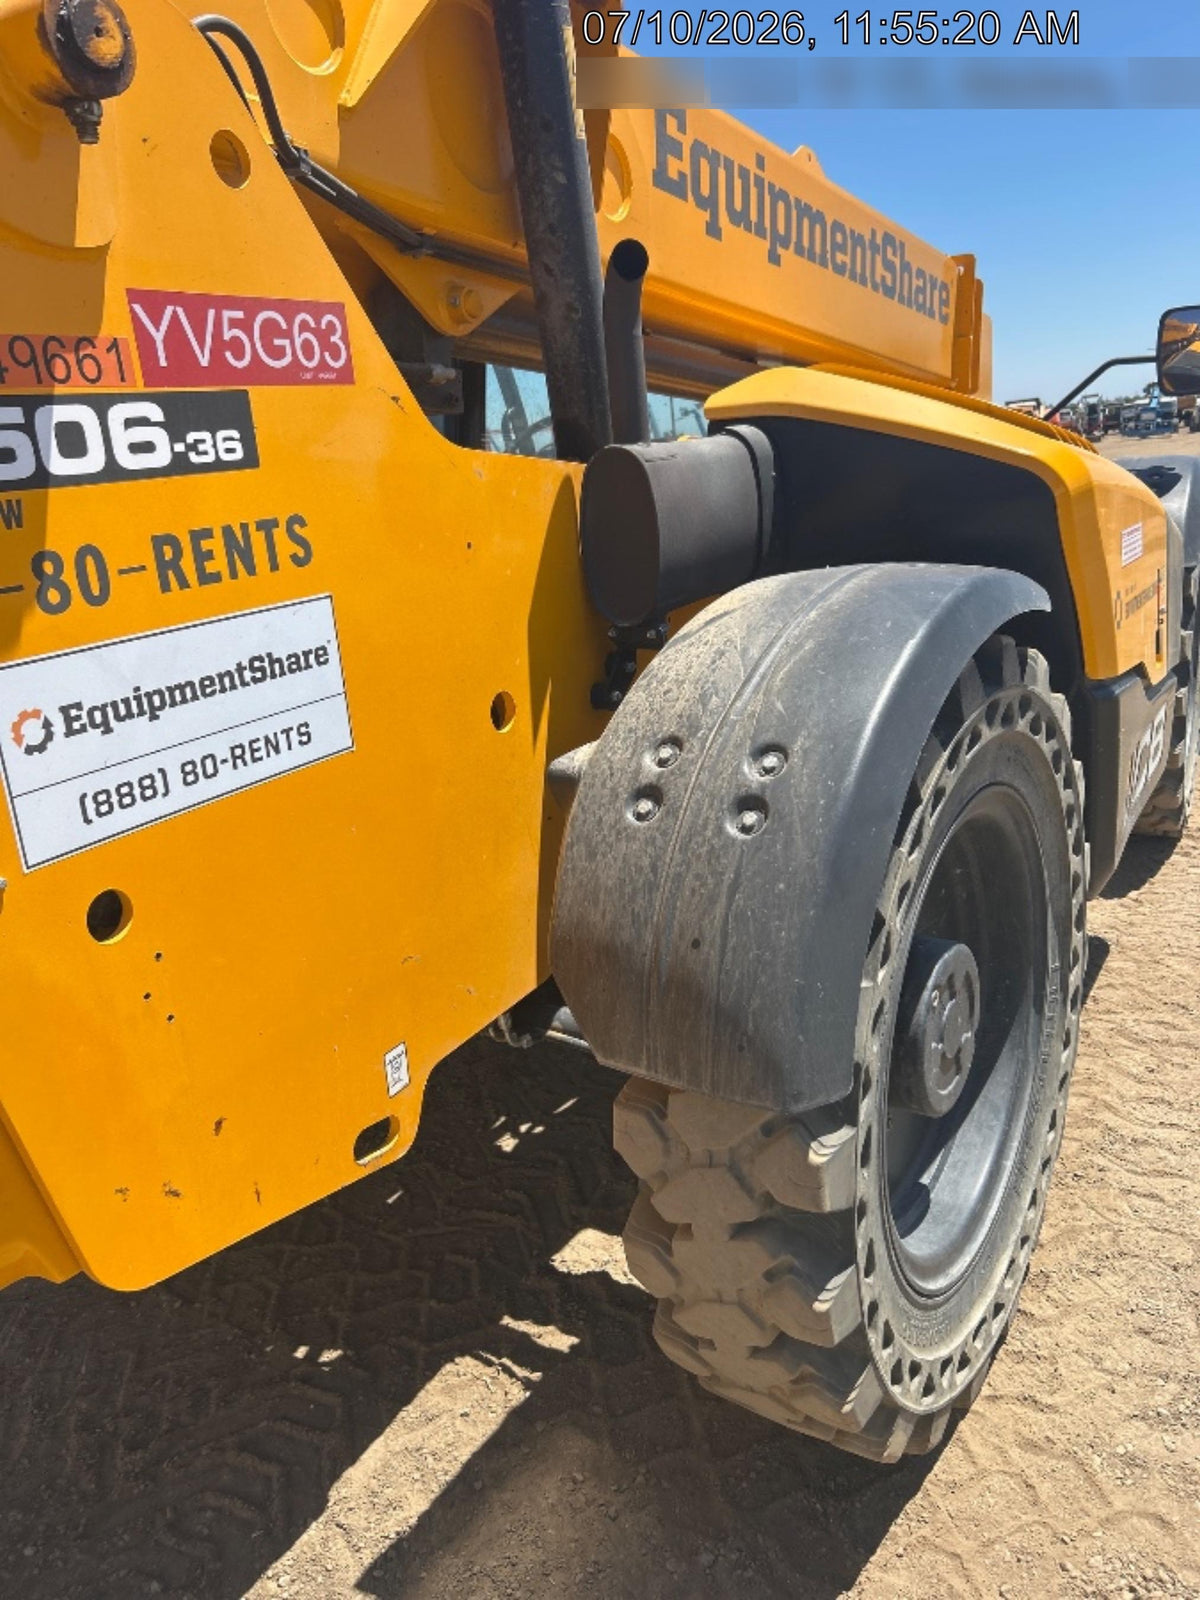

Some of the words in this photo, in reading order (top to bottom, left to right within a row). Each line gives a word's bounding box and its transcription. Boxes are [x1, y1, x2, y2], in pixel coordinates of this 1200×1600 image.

[652, 109, 952, 325] EquipmentShare
[0, 335, 126, 384] 9661
[131, 303, 347, 369] YV5G63
[59, 643, 330, 738] EquipmentShare
[78, 767, 171, 825] (888)
[180, 721, 312, 788] 80-RENTS
